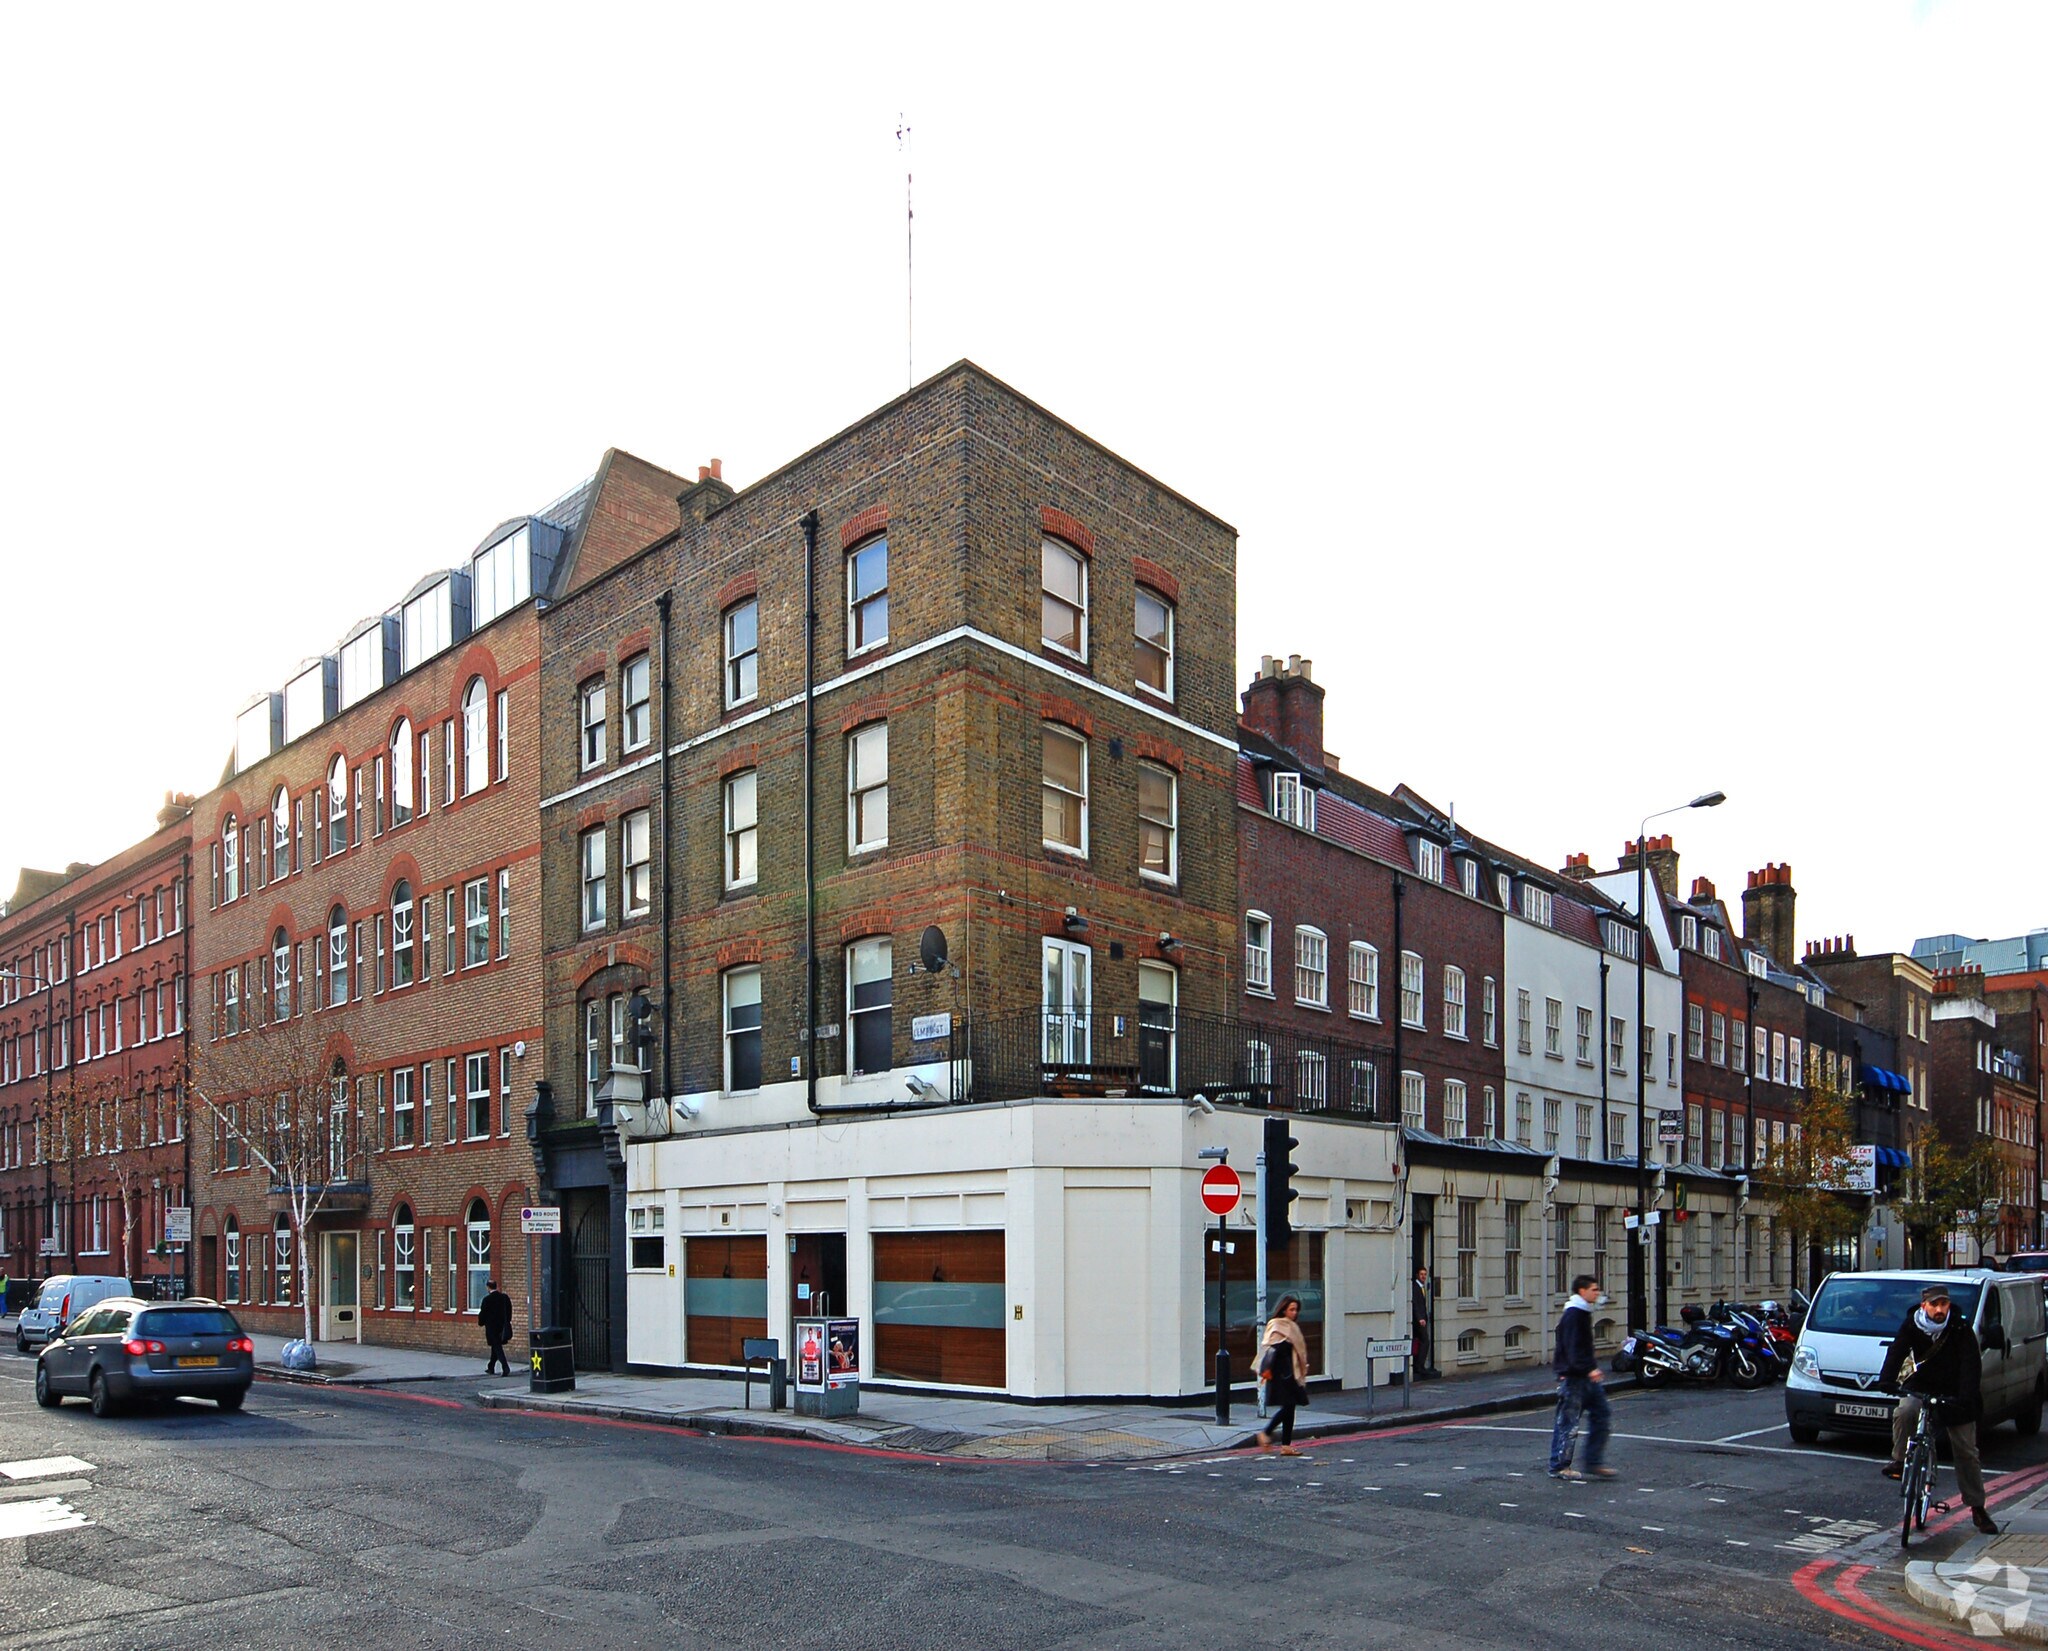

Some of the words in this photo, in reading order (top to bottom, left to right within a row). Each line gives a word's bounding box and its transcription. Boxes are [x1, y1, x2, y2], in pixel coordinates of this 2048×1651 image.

[1386, 1344, 1402, 1352] STREET
[1839, 1404, 1863, 1415] DV57
[1865, 1407, 1885, 1417] UNJ
